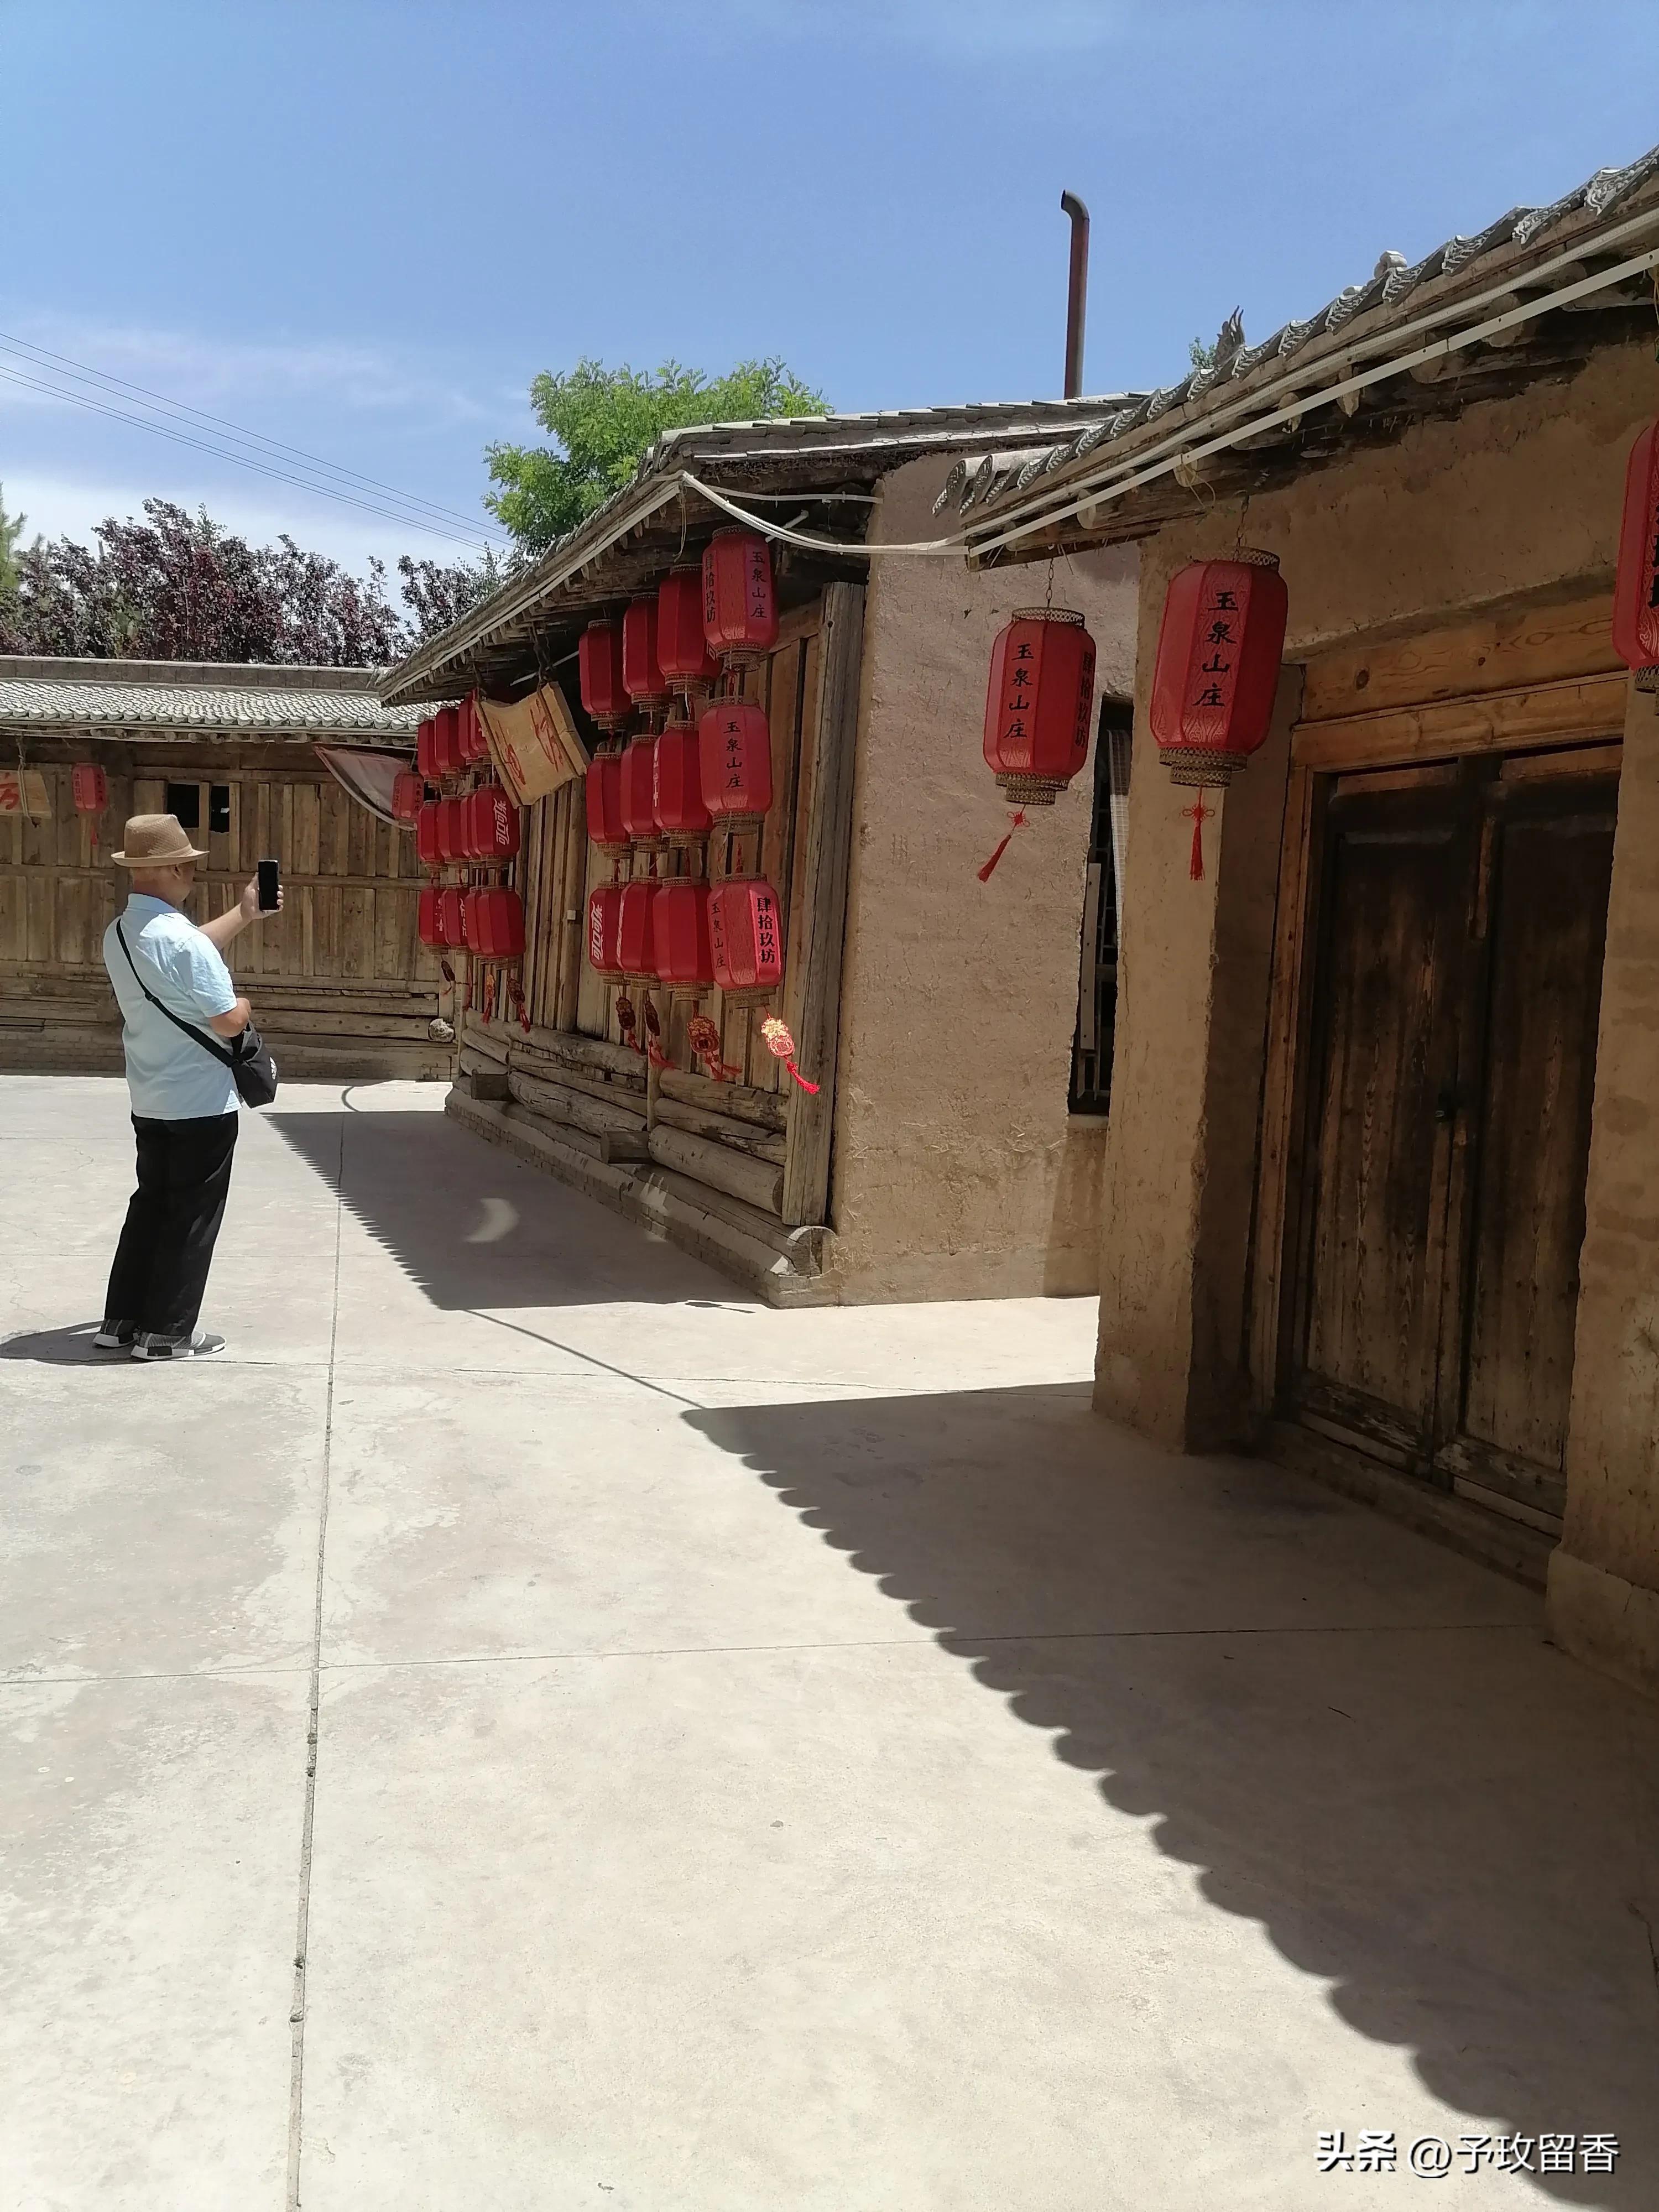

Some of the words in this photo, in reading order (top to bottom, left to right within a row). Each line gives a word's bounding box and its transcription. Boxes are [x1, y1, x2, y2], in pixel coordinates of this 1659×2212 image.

[750, 551, 768, 619] 玉泉山庄
[1192, 591, 1239, 707] 玉泉山庄
[1003, 643, 1035, 739] 玉泉山庄
[723, 721, 745, 789] 玉泉山庄
[493, 797, 510, 846] 可口可乐
[591, 900, 603, 961] 可口可乐
[711, 902, 726, 969] 玉泉山庄
[757, 896, 775, 964] 肆拾玖坊
